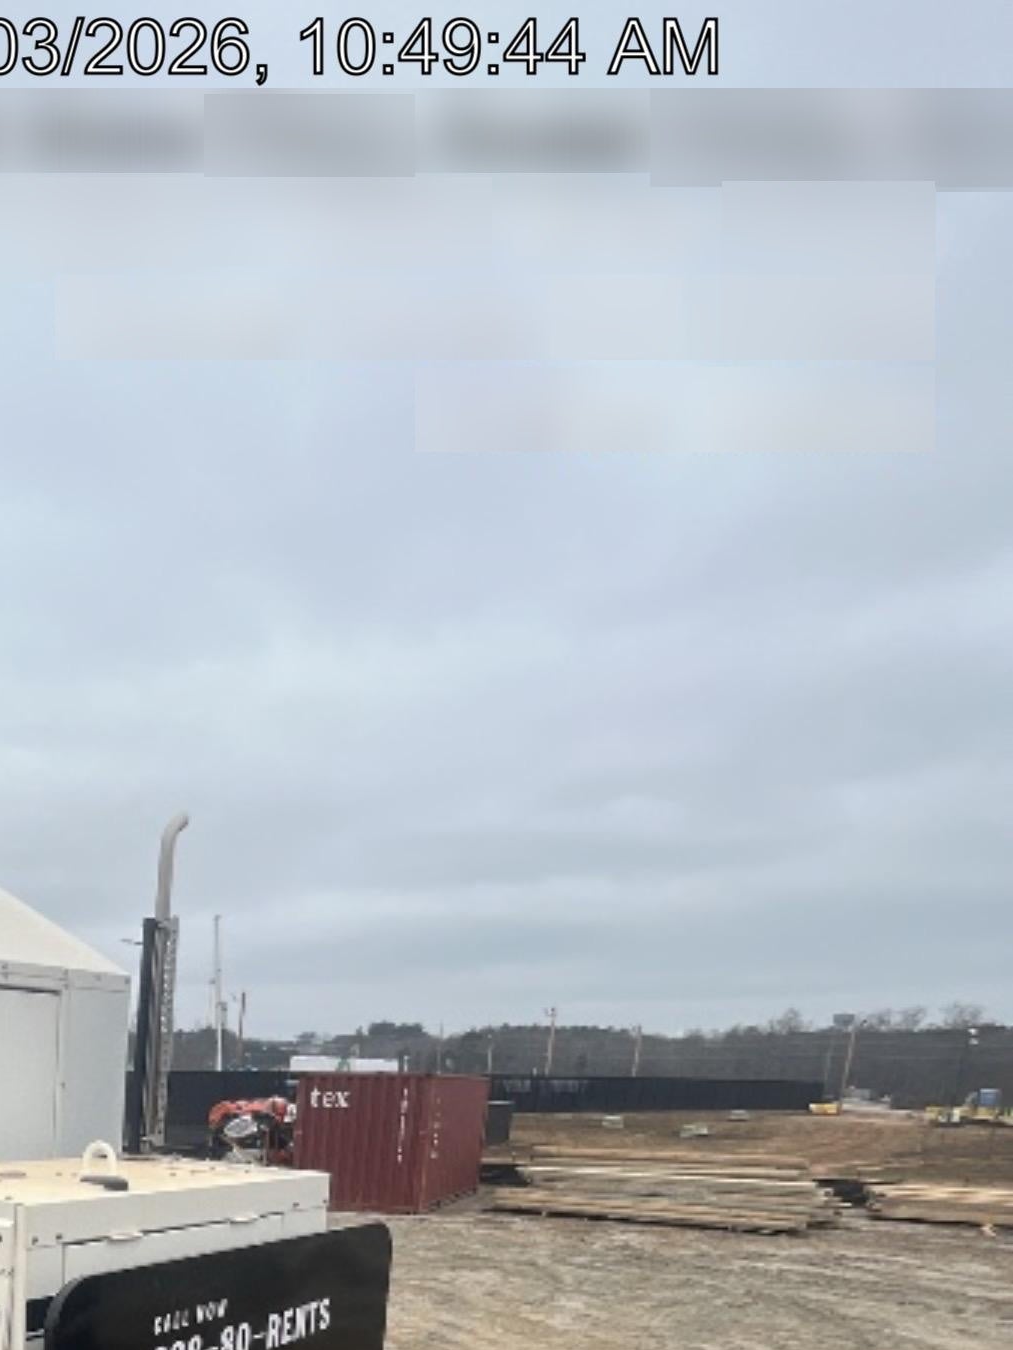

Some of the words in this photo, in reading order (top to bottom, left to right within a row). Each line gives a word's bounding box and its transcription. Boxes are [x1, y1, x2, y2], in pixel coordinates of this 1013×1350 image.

[309, 1086, 352, 1109] tex
[153, 1308, 190, 1336] CALL
[196, 1298, 228, 1325] NOW
